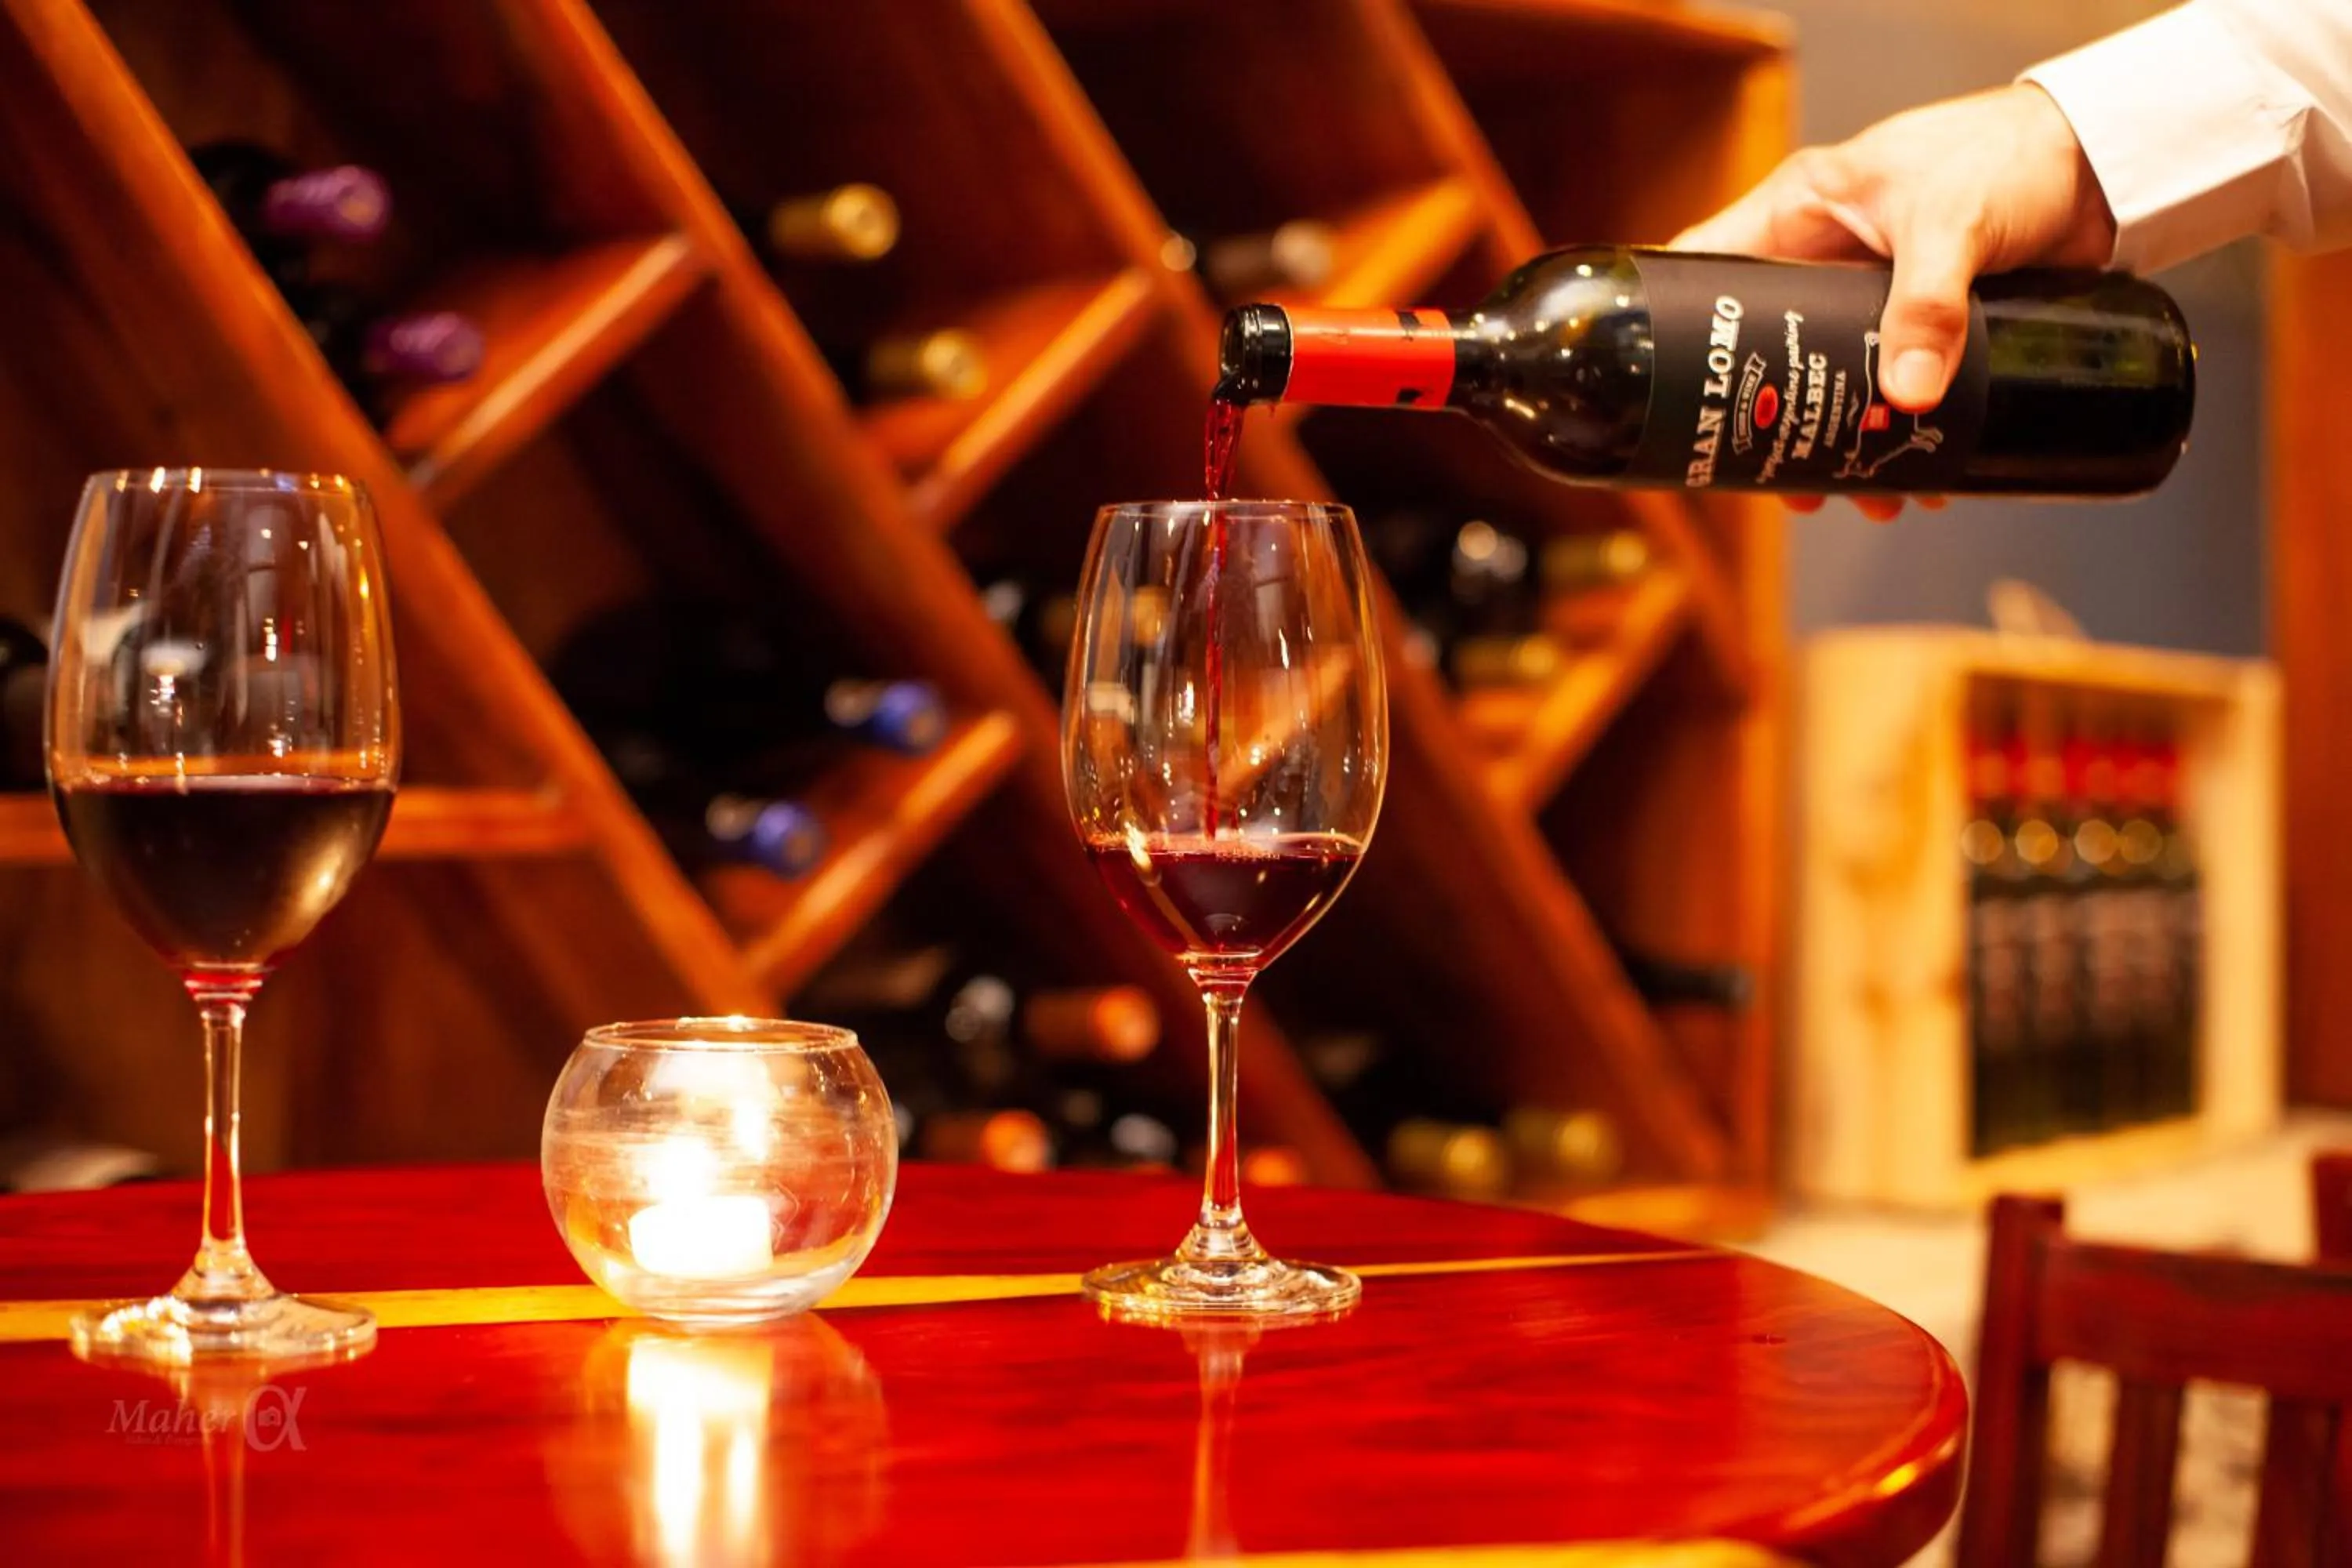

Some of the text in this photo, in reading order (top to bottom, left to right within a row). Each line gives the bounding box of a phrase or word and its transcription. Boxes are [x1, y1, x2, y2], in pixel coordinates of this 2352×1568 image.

[1686, 295, 1744, 487] GRAN LOMO
[1791, 352, 1828, 460] MALBEC
